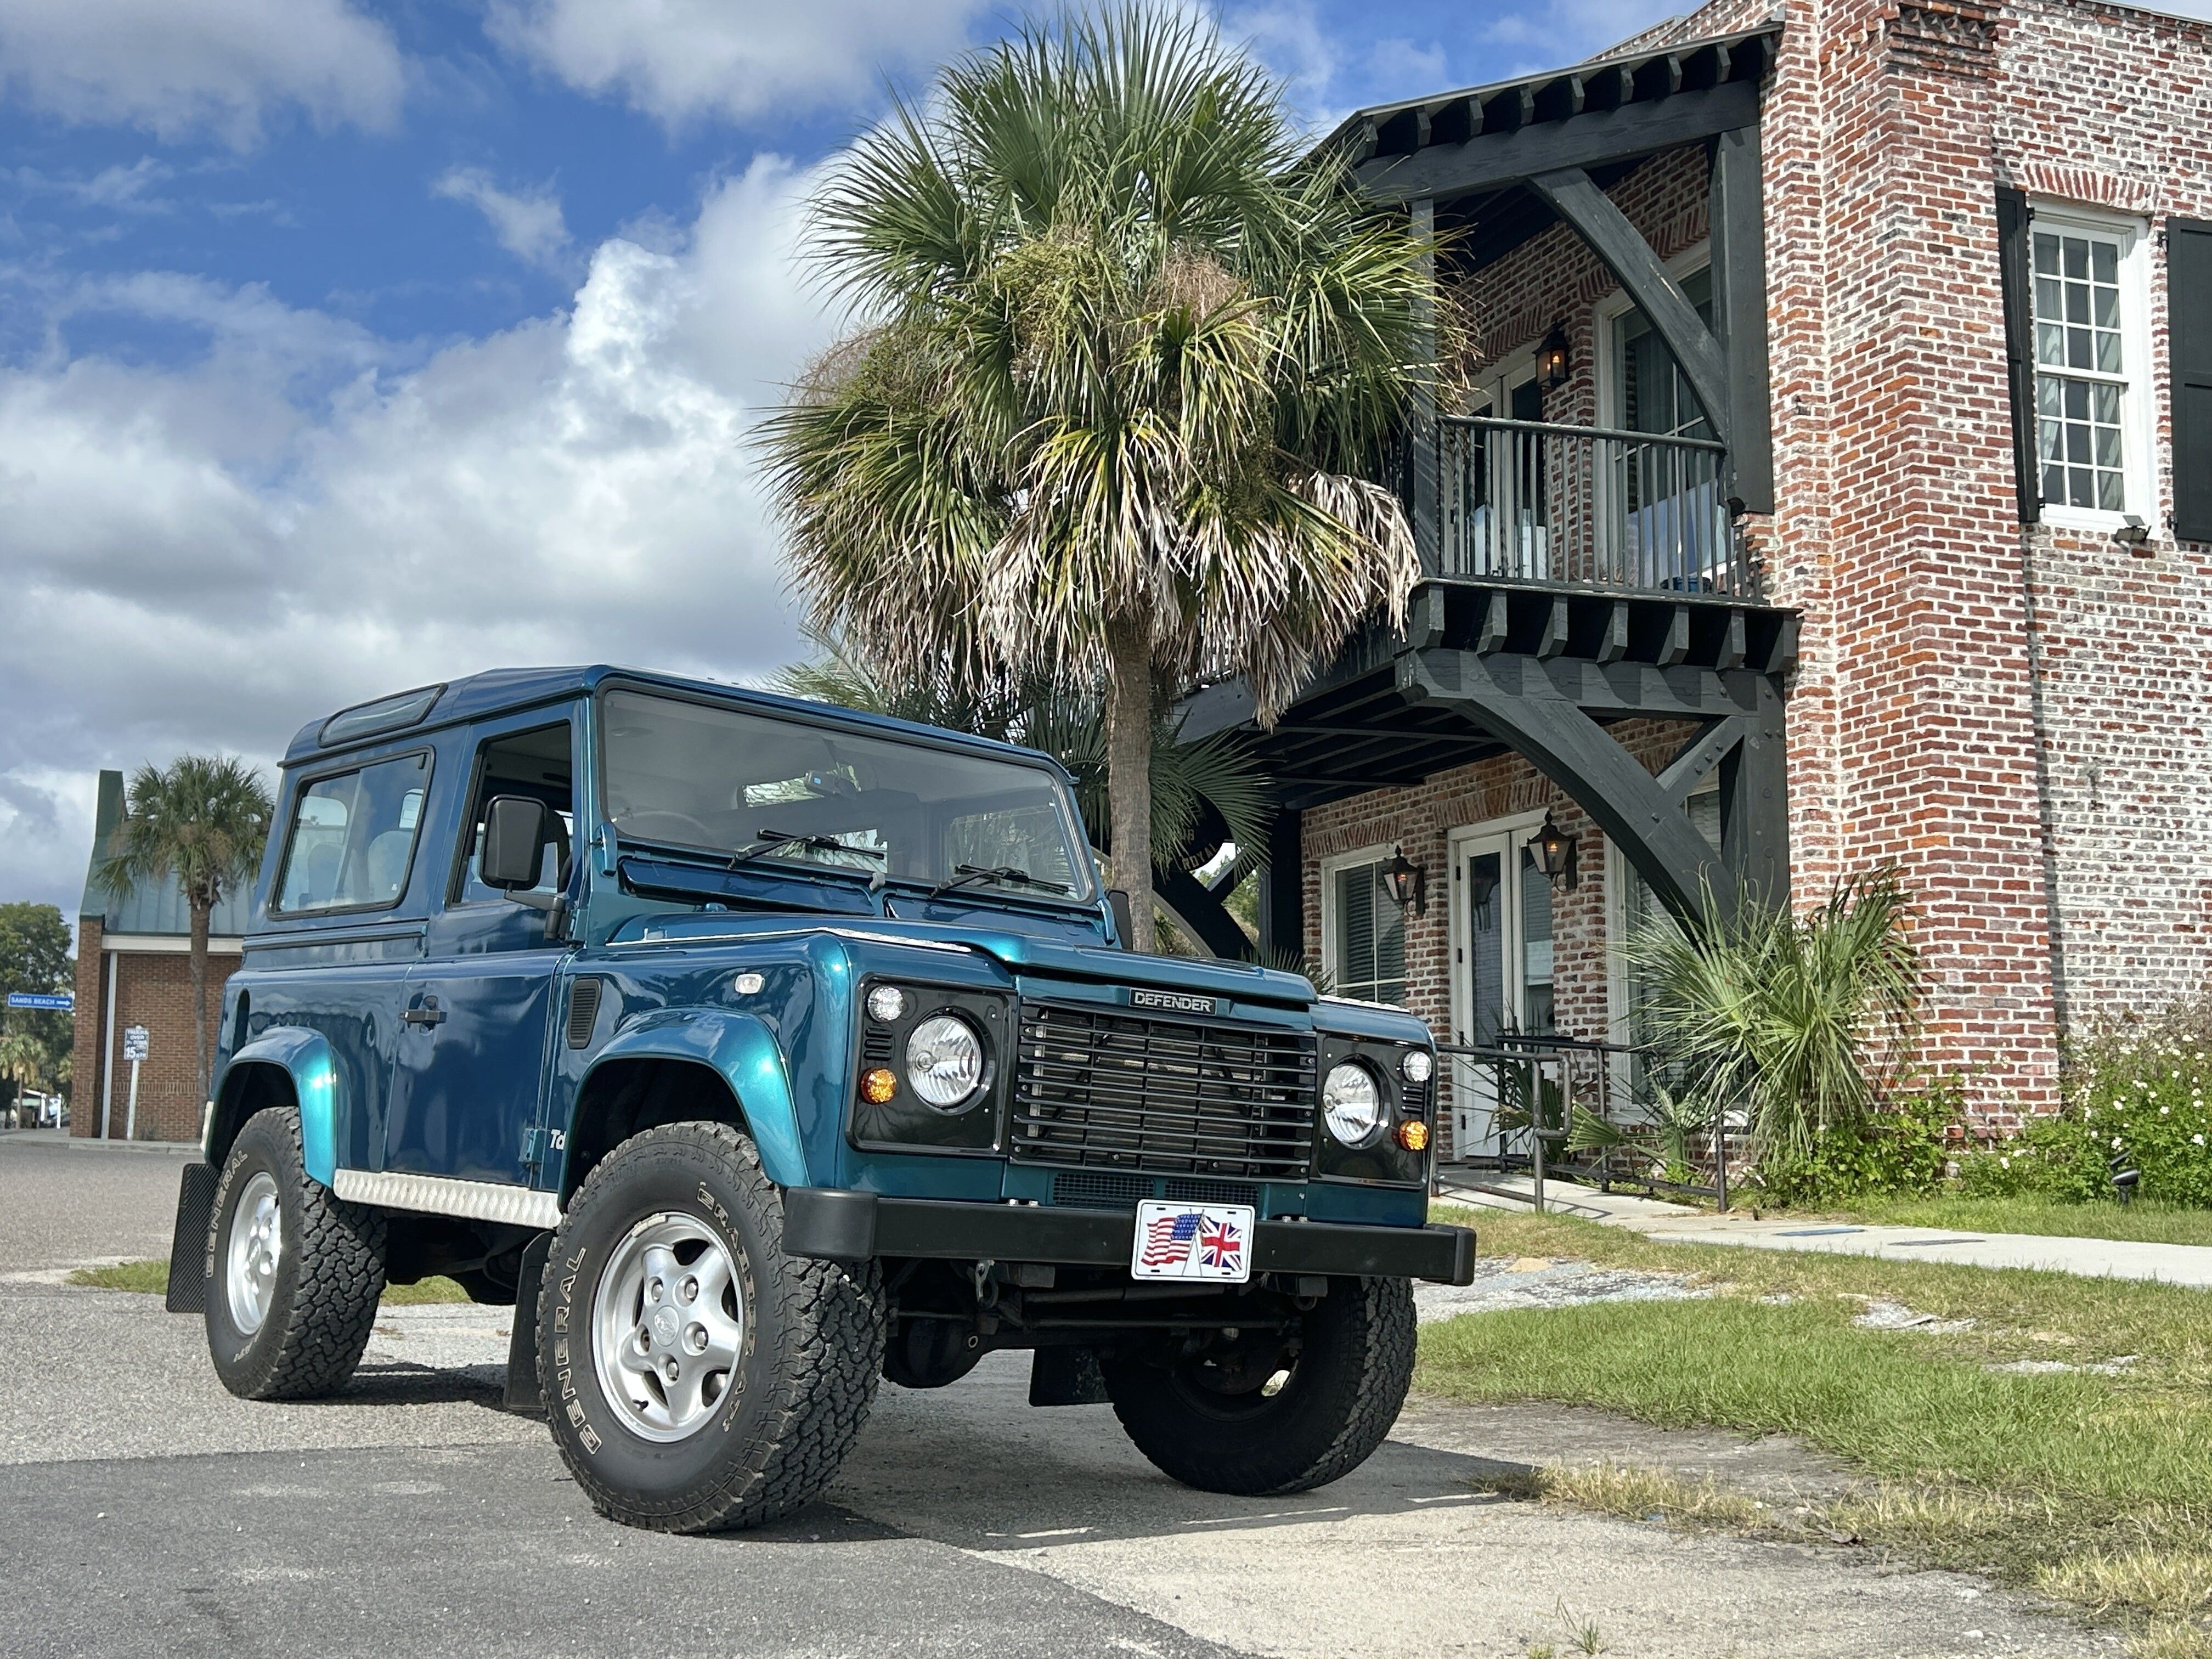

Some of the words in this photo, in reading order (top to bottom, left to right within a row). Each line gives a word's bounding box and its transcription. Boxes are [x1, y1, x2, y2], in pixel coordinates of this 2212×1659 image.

[11, 996, 32, 1005] SANDS
[1134, 991, 1212, 1012] DEFENDER
[126, 1046, 136, 1059] 15
[206, 1150, 249, 1279] GENERAL
[554, 1246, 602, 1455] GENERAL
